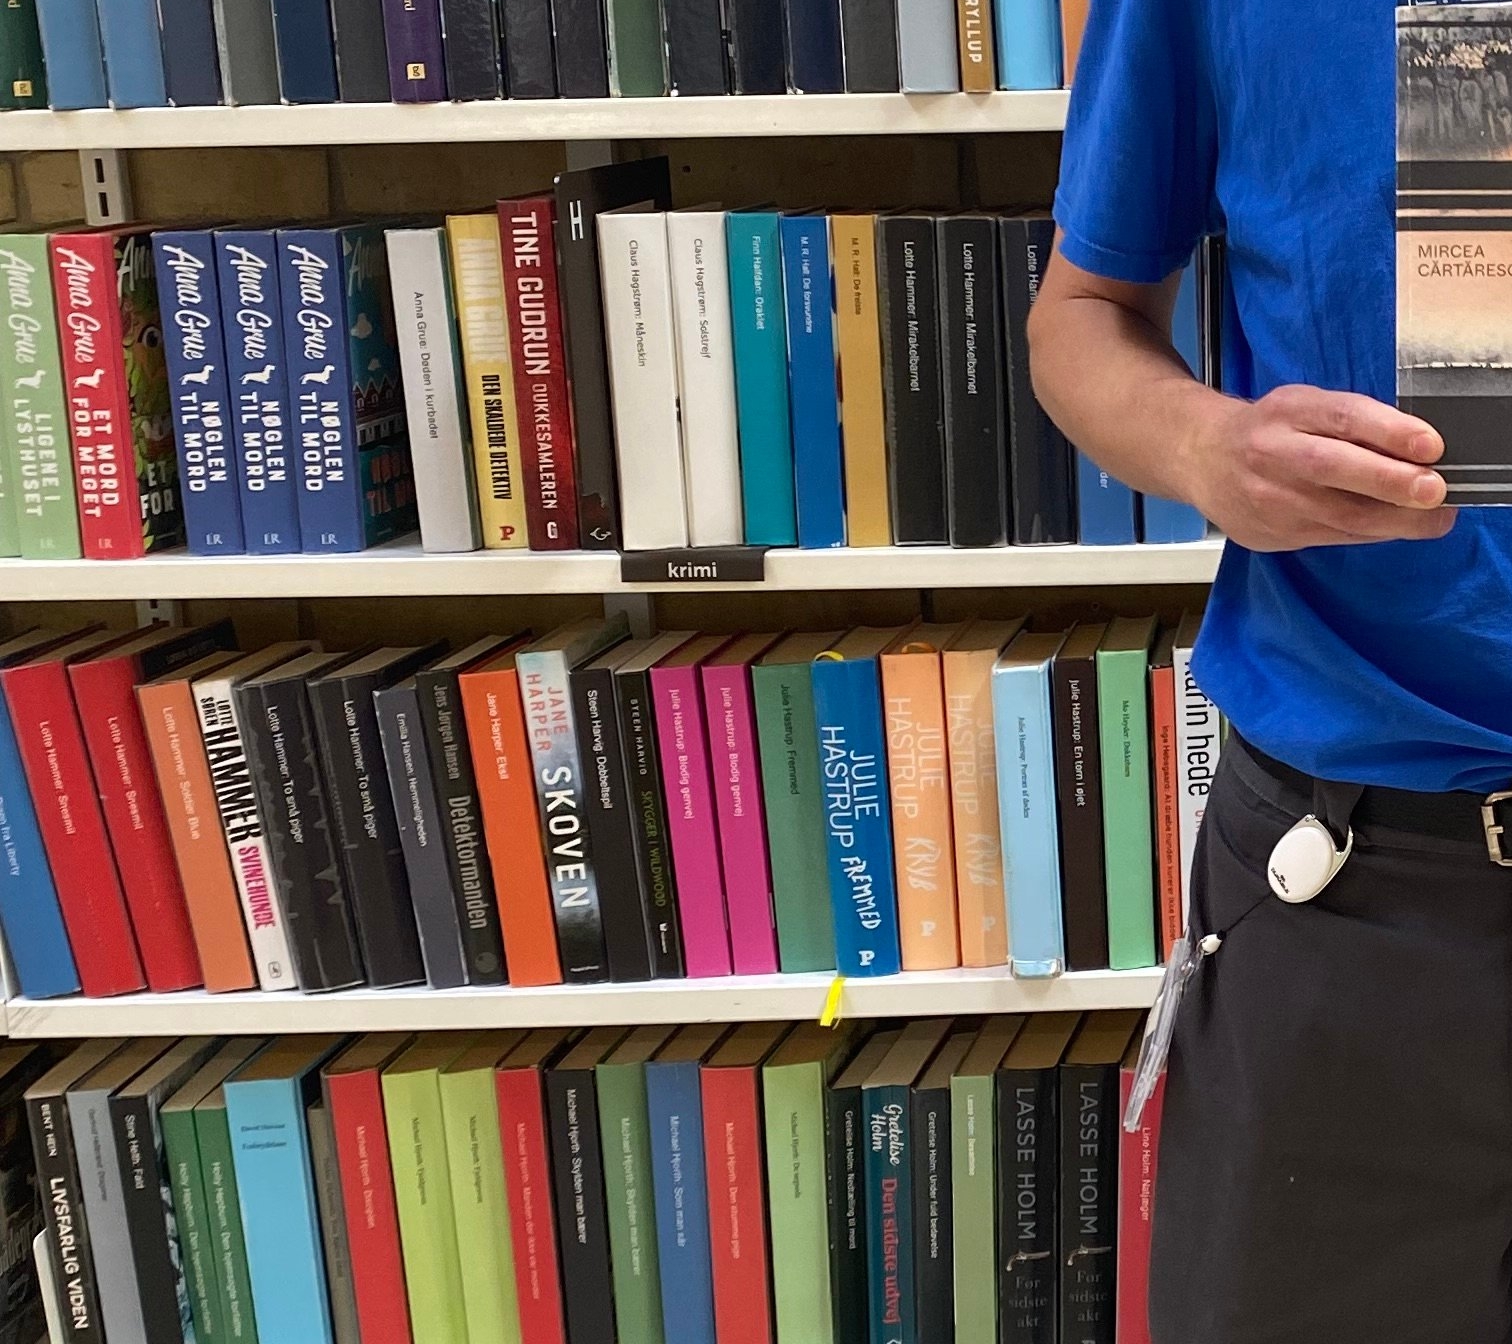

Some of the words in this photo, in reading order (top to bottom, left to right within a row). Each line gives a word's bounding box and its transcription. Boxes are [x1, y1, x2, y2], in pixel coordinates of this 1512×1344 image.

[511, 212, 541, 267] TINE
[629, 240, 640, 266] Claus
[1417, 244, 1485, 259] MIRCEA
[288, 245, 328, 306] Anna
[630, 269, 643, 319] Hagstrøm:
[296, 309, 332, 359] Grue
[516, 277, 550, 375] GUDRUN
[635, 323, 647, 366] Måneskin
[300, 392, 318, 423] TIL
[482, 375, 501, 396] DEN
[320, 401, 343, 481] NØGLEN
[483, 399, 507, 448] SKALDEDE
[532, 384, 557, 509] DUKKESAMLEREN
[303, 432, 323, 491] MORD
[490, 452, 512, 500] DETEKTIV
[668, 561, 717, 578] krimi
[200, 697, 218, 726] SØREN
[217, 700, 233, 725] LOTTE
[433, 685, 449, 708] Jens
[526, 674, 550, 751] HARPER
[548, 687, 568, 734] JANE
[436, 710, 453, 742] Jørgen
[444, 745, 461, 779] Hansen
[821, 726, 853, 848] HASTRUP
[849, 750, 880, 821] JULIE
[1187, 734, 1215, 797] hede
[205, 726, 264, 844] HAMMER
[238, 846, 275, 929] SVINEHUNDE
[541, 766, 590, 908] SKOVEN
[447, 795, 489, 929] Detektormanden
[841, 856, 882, 930] FREMMED
[871, 1114, 887, 1152] Holm
[884, 1104, 904, 1166] Gretelise
[1079, 1082, 1098, 1157] LASSE
[40, 1104, 54, 1129] BENT
[49, 1178, 81, 1274] LIVSFARLIG
[67, 1278, 89, 1328] VIDEN
[882, 1177, 899, 1214] Den
[1079, 1168, 1098, 1234] HOLM
[883, 1219, 900, 1272] sidste
[882, 1276, 900, 1324] udvej
